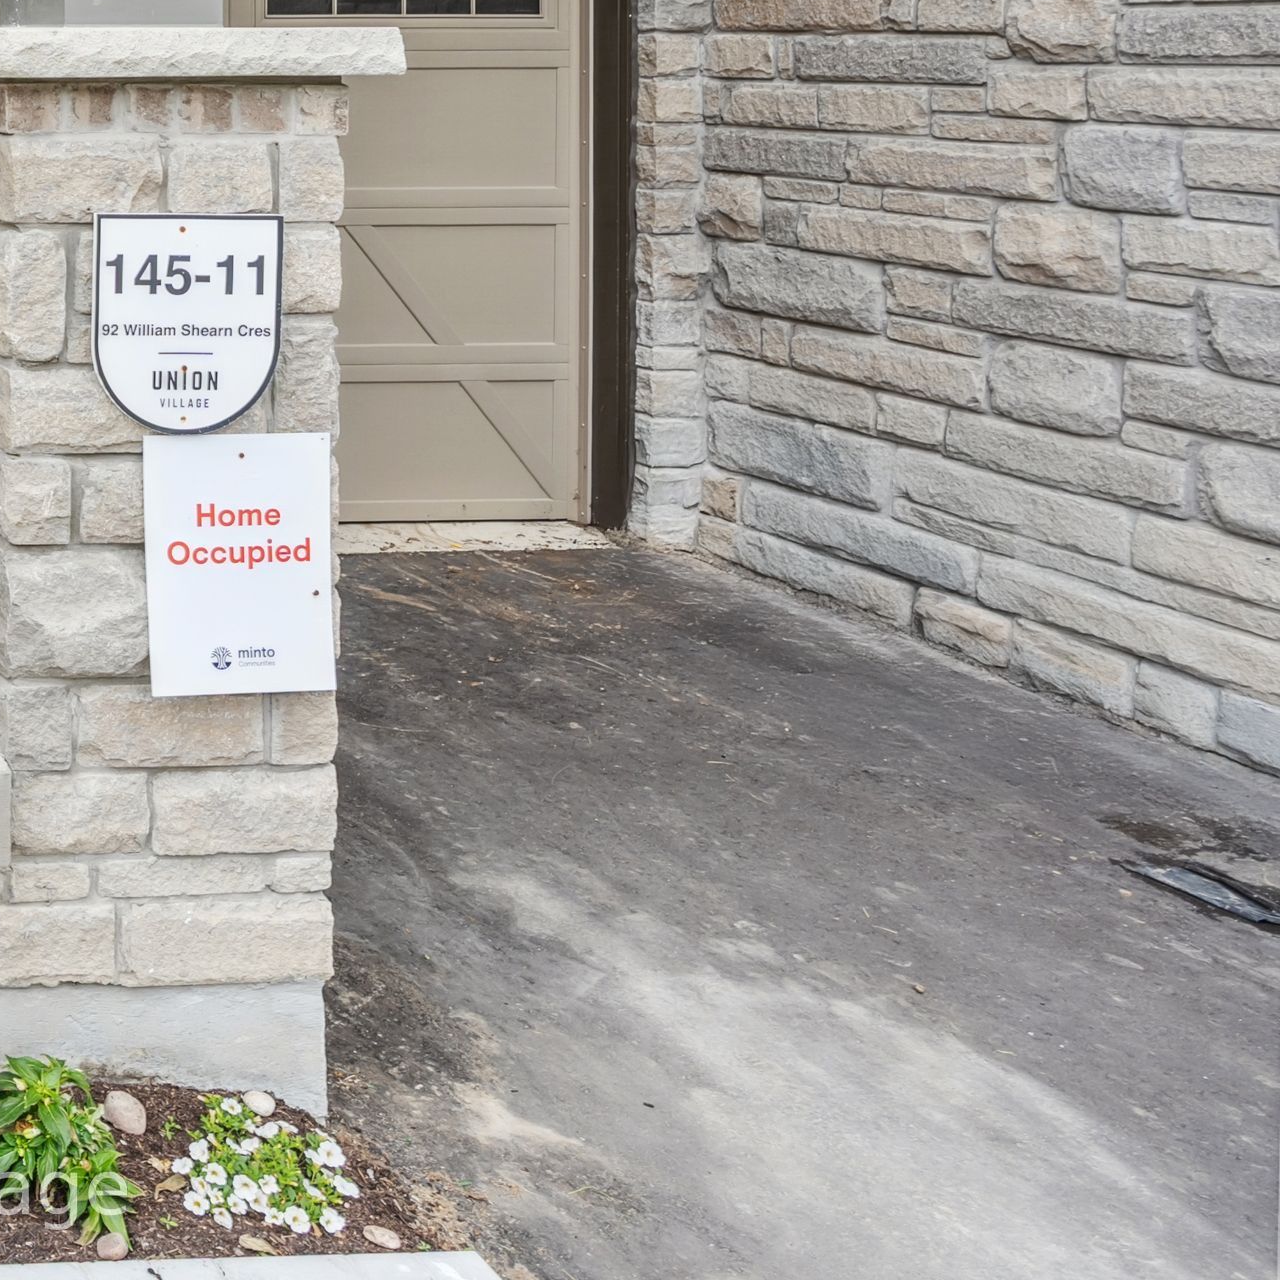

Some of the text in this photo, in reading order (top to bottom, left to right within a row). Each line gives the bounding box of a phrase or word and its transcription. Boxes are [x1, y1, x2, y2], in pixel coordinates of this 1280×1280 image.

[106, 254, 264, 295] 145-11
[102, 324, 271, 337] 92 William Shearn Cres
[152, 370, 218, 390] UNION
[160, 398, 209, 408] VILLAGE
[196, 503, 281, 527] Home
[167, 537, 311, 569] Occupied
[238, 646, 275, 658] minto
